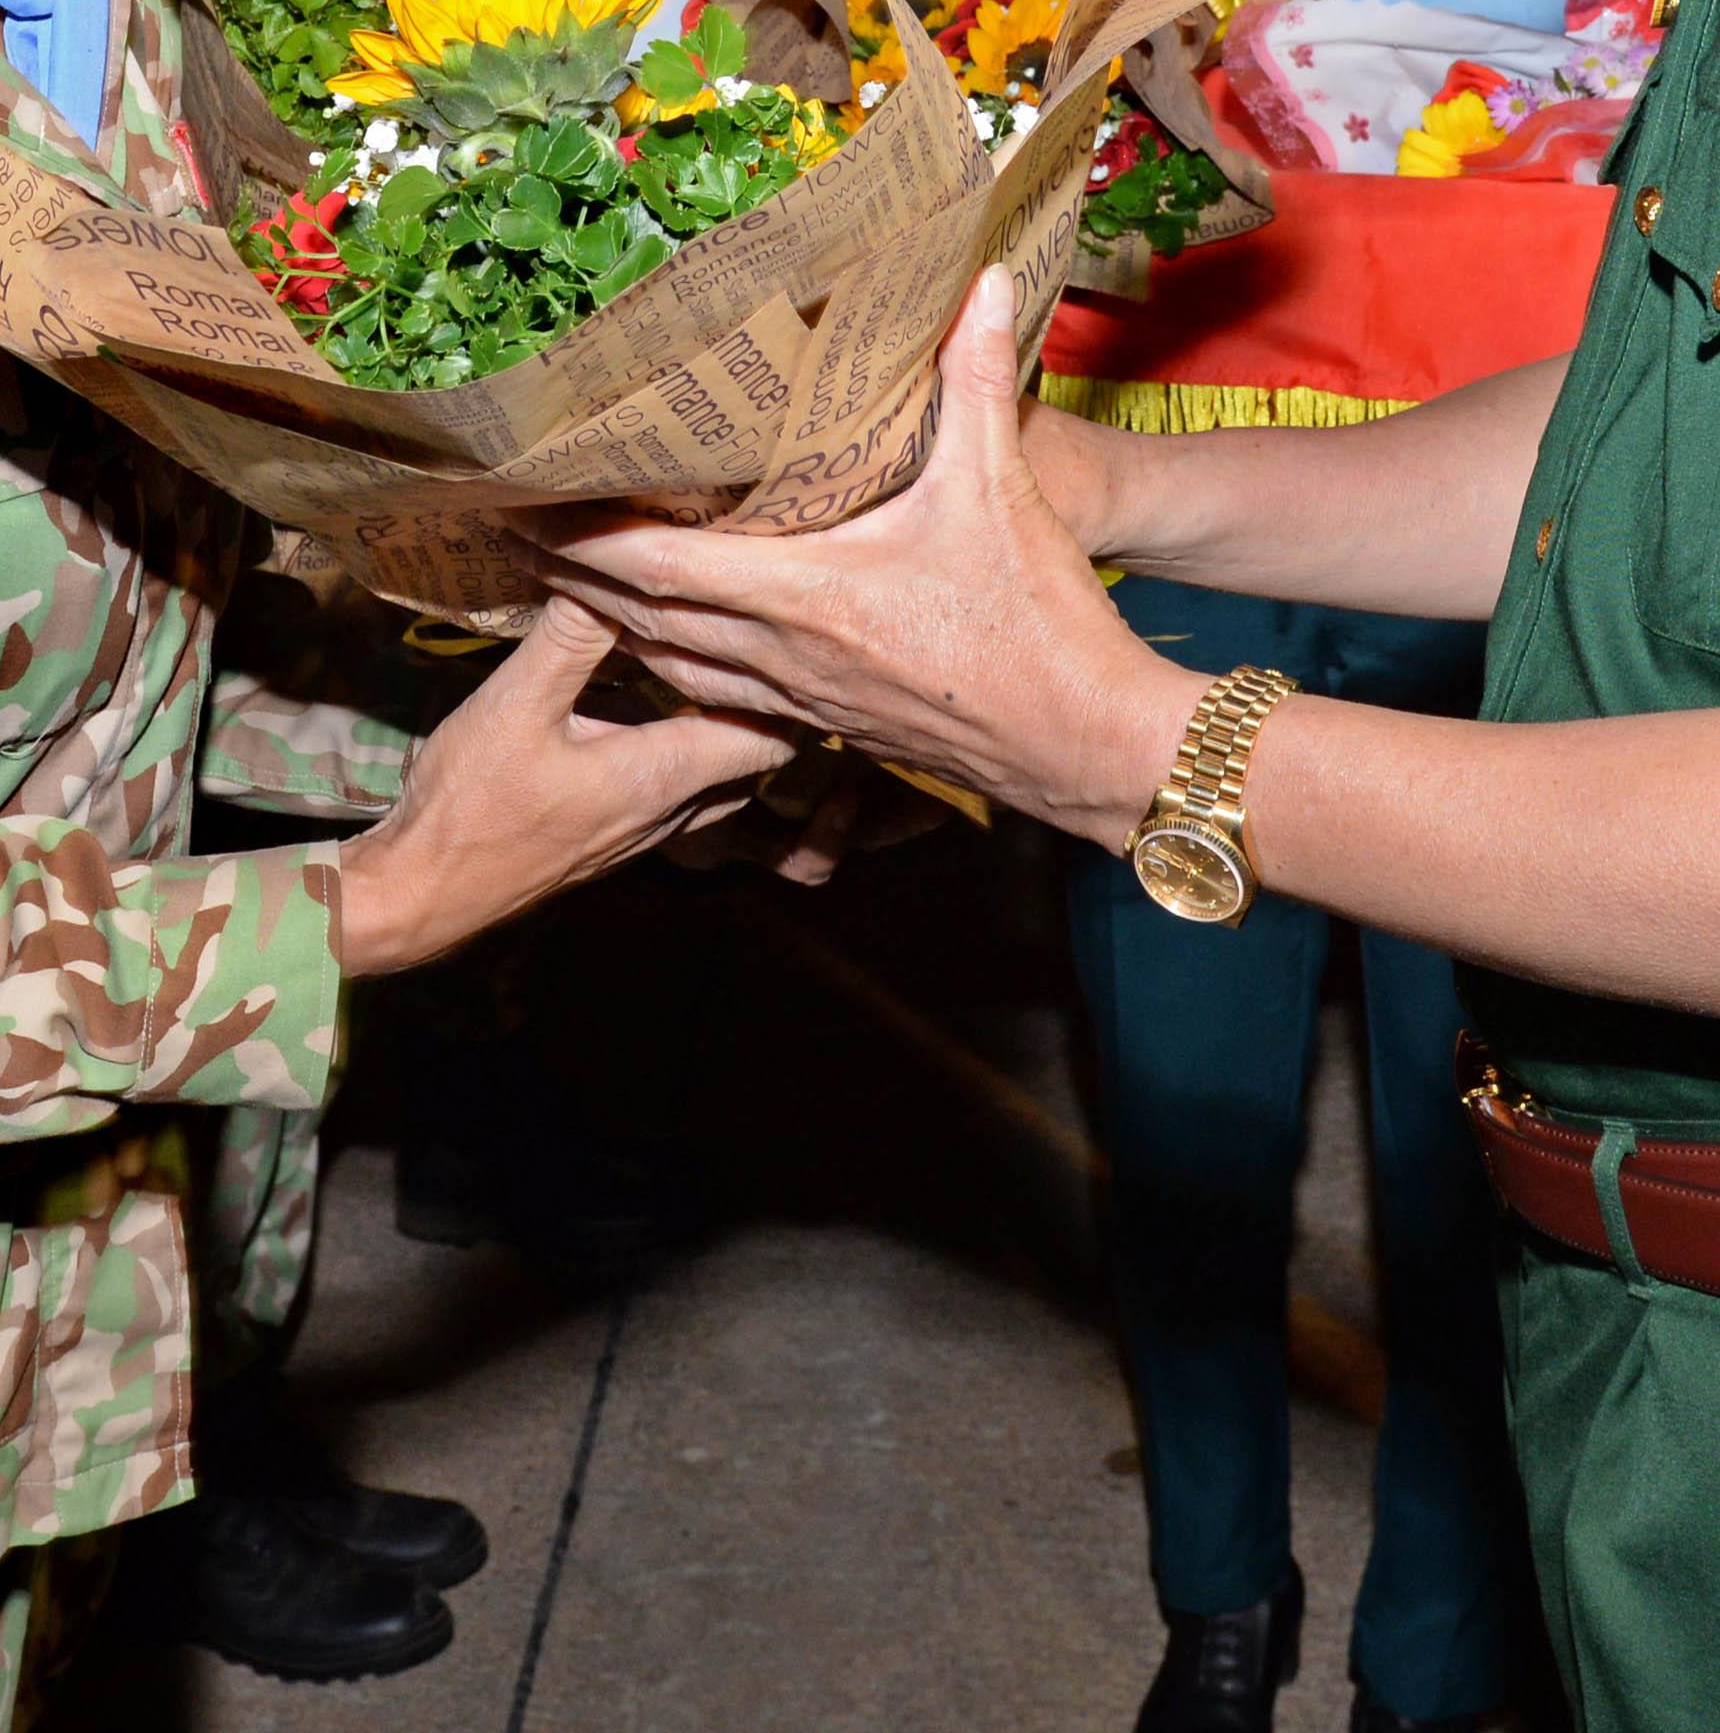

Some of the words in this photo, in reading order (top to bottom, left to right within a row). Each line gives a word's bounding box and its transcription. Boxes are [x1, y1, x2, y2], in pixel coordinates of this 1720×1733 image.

[778, 93, 915, 215] Flower
[670, 222, 798, 292] Romance
[674, 233, 802, 304] Romance
[795, 310, 859, 441] Romance
[835, 291, 895, 423] Romance
